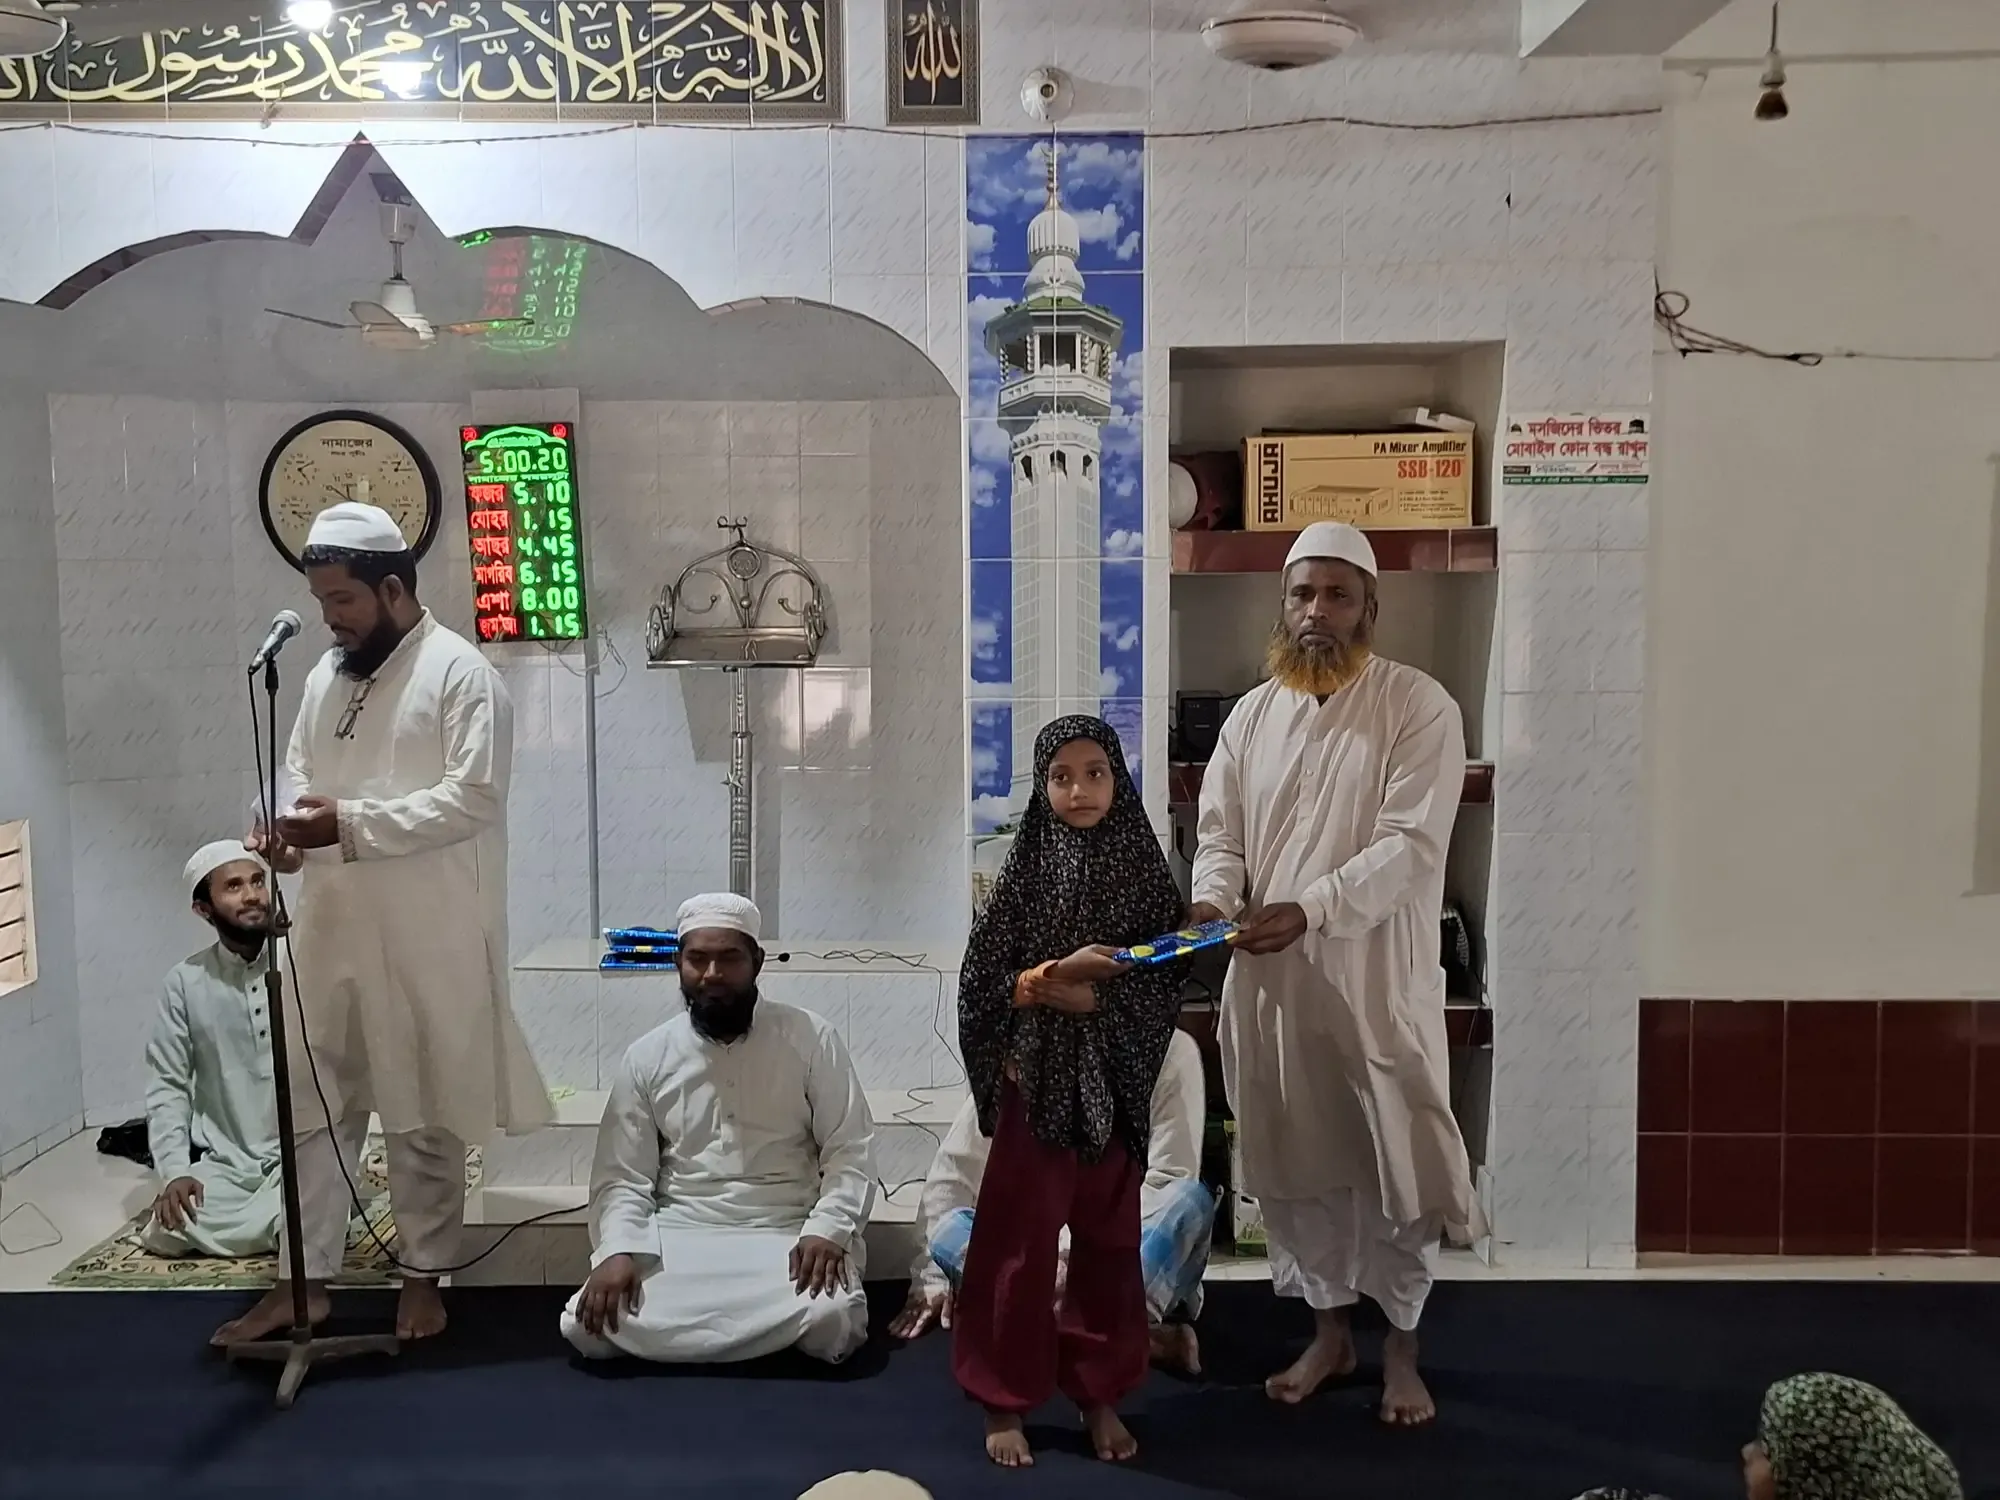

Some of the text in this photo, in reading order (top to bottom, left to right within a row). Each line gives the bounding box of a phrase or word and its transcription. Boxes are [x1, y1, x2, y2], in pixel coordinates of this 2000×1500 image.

[1527, 416, 1622, 437] মসজিদের ভিতর
[1373, 440, 1467, 454] PA Mixer Amplifier
[1506, 438, 1649, 460] মোবাইল ফোন বন্ধ রাখুন
[1397, 459, 1462, 478] SSB-120
[1263, 443, 1279, 523] AHUJA
[476, 590, 511, 611] এশা
